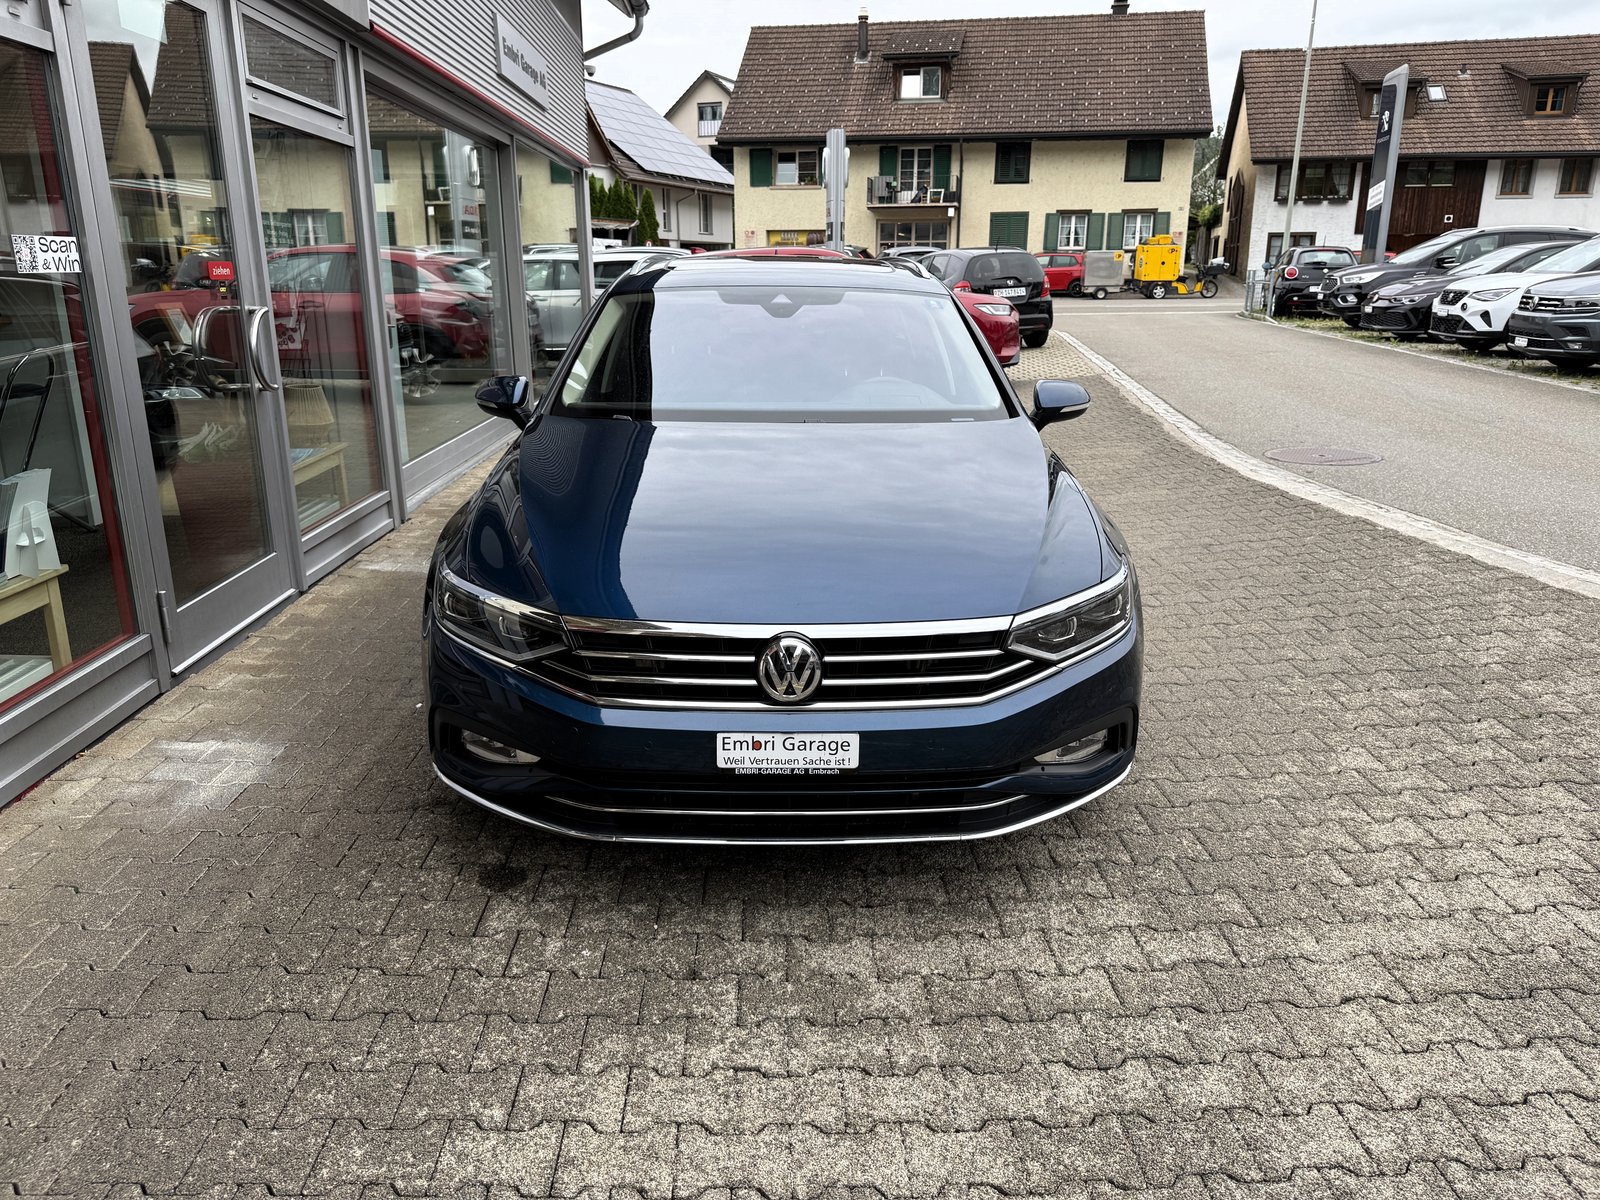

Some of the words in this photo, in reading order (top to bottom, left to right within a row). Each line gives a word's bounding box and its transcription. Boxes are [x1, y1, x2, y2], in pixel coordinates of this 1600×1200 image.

[502, 36, 520, 67] Embri
[520, 53, 539, 85] Garage
[38, 236, 78, 253] Scan
[42, 258, 51, 270] &
[52, 254, 81, 272] Win
[212, 265, 230, 275] ziehen
[722, 735, 775, 751] Embri
[782, 736, 851, 756] Garage
[723, 756, 745, 766] Weil
[748, 756, 800, 766] Vertrauen
[802, 756, 832, 766] Sache
